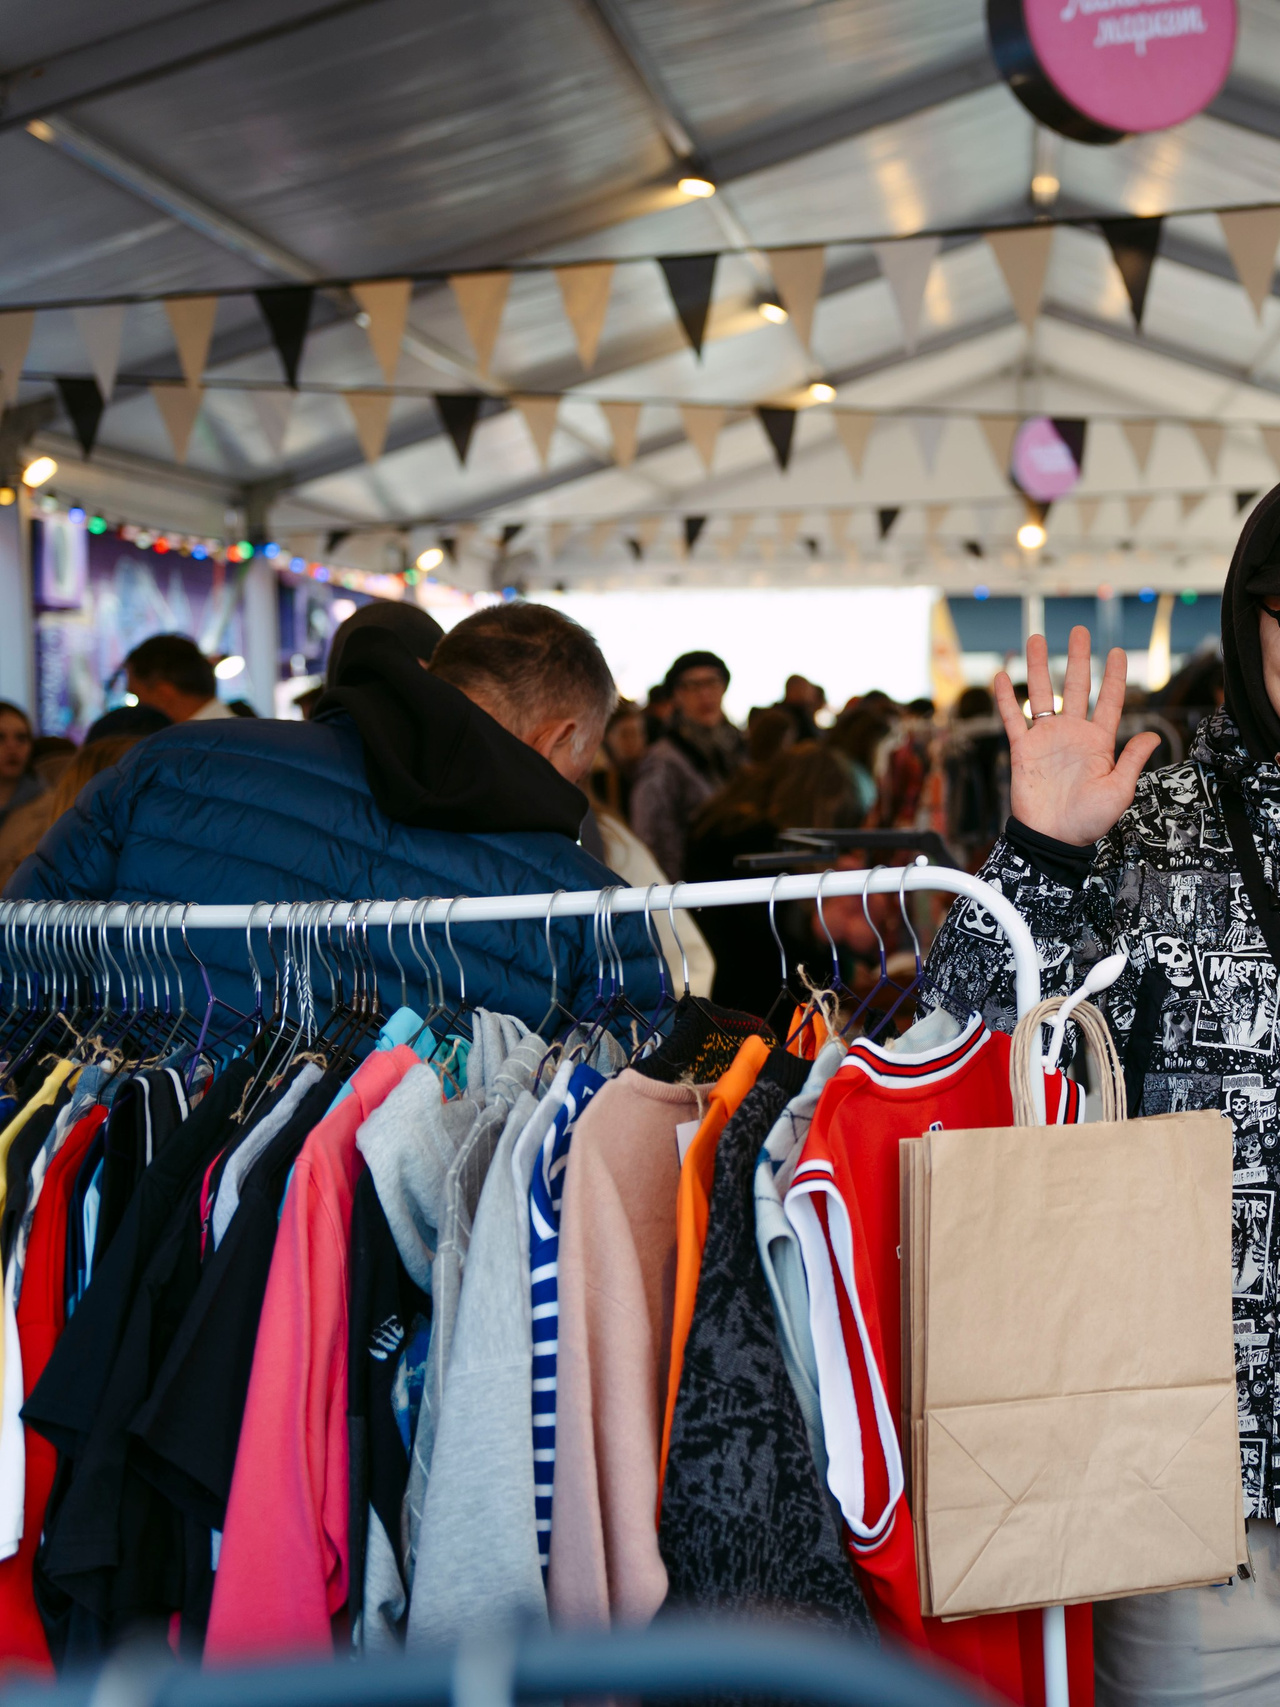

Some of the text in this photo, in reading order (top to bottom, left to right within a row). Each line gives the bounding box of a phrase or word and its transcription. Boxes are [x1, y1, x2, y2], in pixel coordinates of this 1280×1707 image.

[1171, 875, 1202, 886] MISFITS
[1209, 956, 1277, 982] MISFITS
[1199, 1020, 1217, 1031] FRIDAY
[1168, 1077, 1193, 1089] MISFITS
[1223, 1076, 1261, 1089] HORROR
